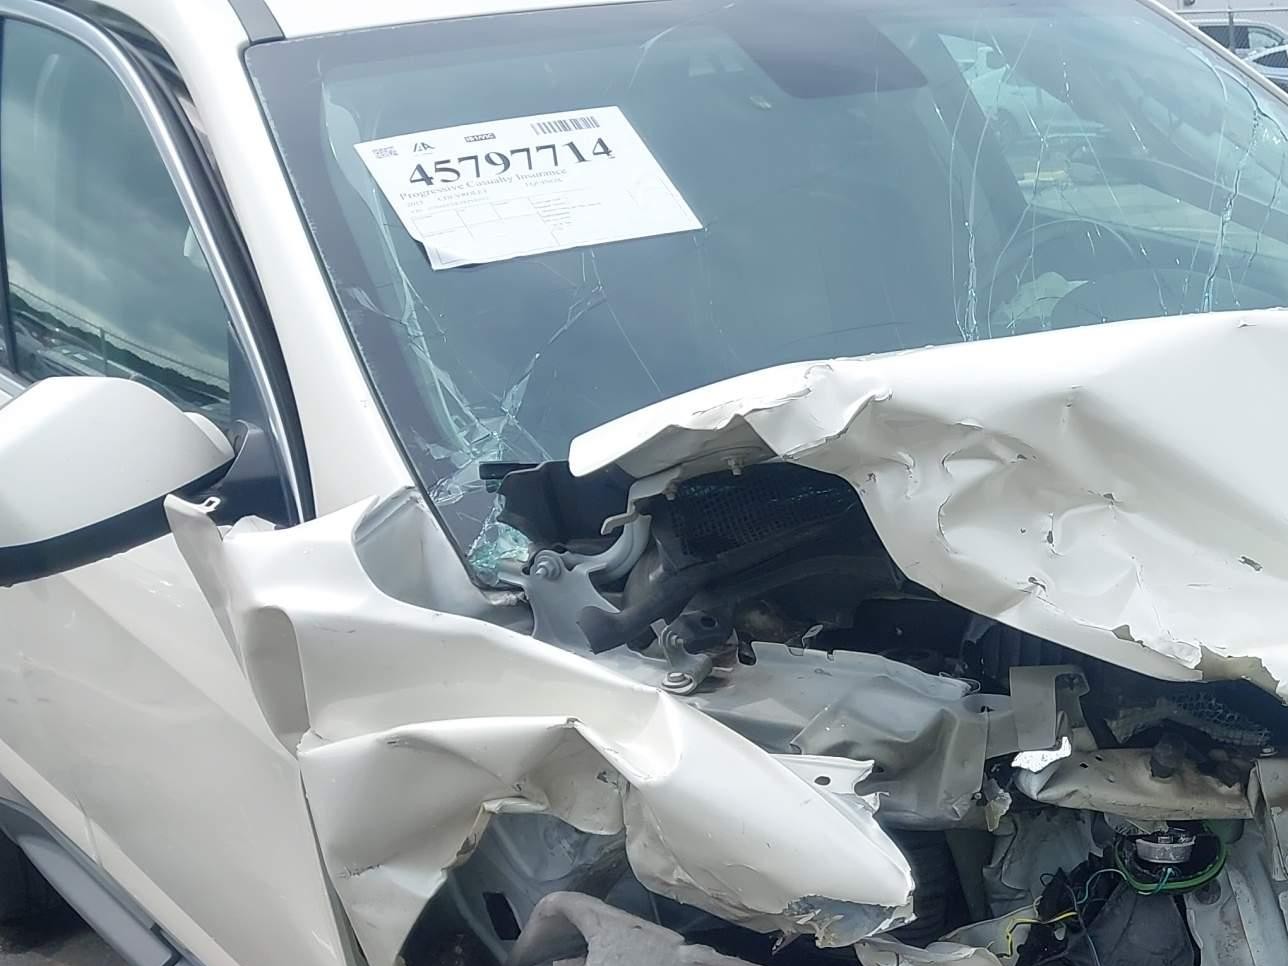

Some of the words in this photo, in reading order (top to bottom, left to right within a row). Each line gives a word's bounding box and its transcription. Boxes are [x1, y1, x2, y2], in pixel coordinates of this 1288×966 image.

[408, 137, 613, 187] 45797714
[399, 184, 465, 201] Progressive
[465, 175, 513, 190] Casualty
[516, 168, 568, 182] Insurance
